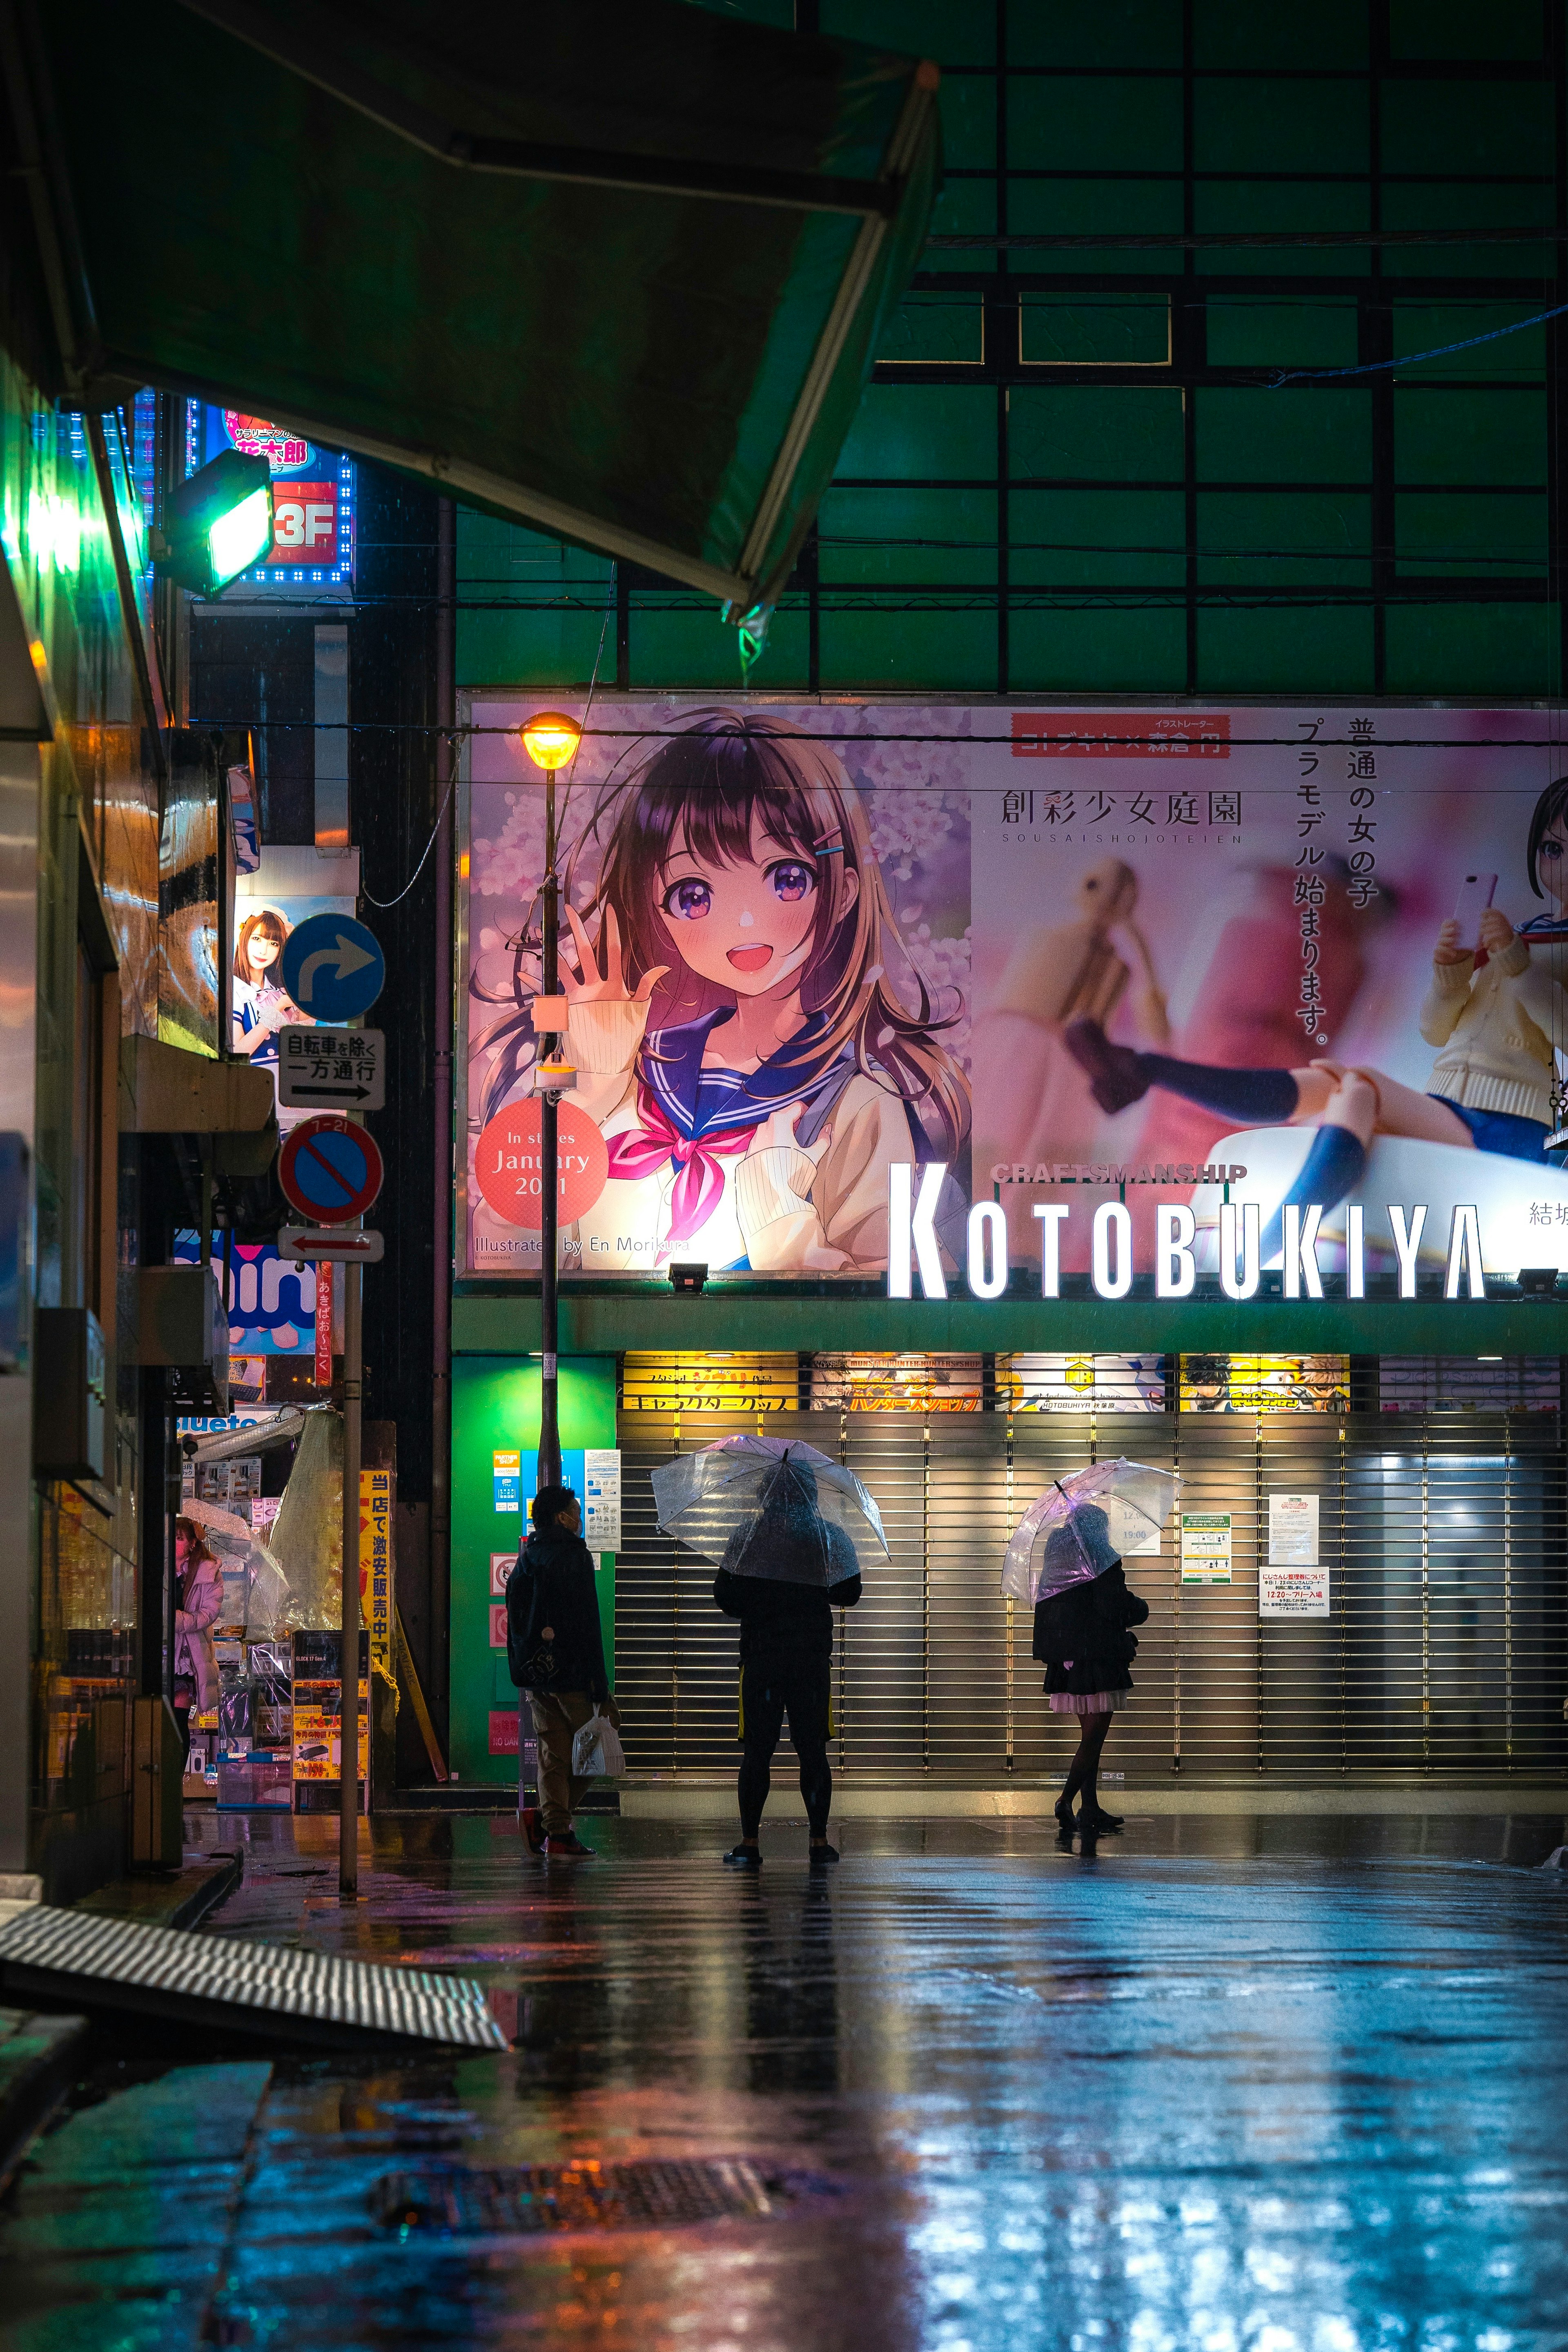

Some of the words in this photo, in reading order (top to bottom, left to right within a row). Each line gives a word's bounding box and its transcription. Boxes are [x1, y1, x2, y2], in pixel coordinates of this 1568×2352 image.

[237, 440, 307, 463] 花太郎
[275, 503, 333, 547] 3F
[1155, 720, 1214, 728] イラストレーター
[1000, 791, 1242, 826] 創彩少女庭園
[1348, 717, 1378, 908] 普通の女の子
[1295, 717, 1327, 1044] プラモデル始まります。
[288, 1033, 376, 1057] 自転車を除く
[288, 1059, 376, 1081] 一方通行
[313, 1120, 347, 1133] 7-21
[508, 1132, 521, 1144] In
[528, 1133, 575, 1144] stes
[990, 1163, 1248, 1185] CRAFTSMANSHIP
[515, 1177, 566, 1195] 201
[887, 1161, 1486, 1301] KOTOBUKIYA
[475, 1238, 543, 1252] Illustrate
[564, 1237, 583, 1255] by
[590, 1238, 609, 1251] En
[617, 1237, 690, 1251] Morikura
[850, 1390, 980, 1411] ハンターズショップ
[372, 1474, 388, 1639] 当店で激安販売中
[493, 1737, 503, 1746] NO
